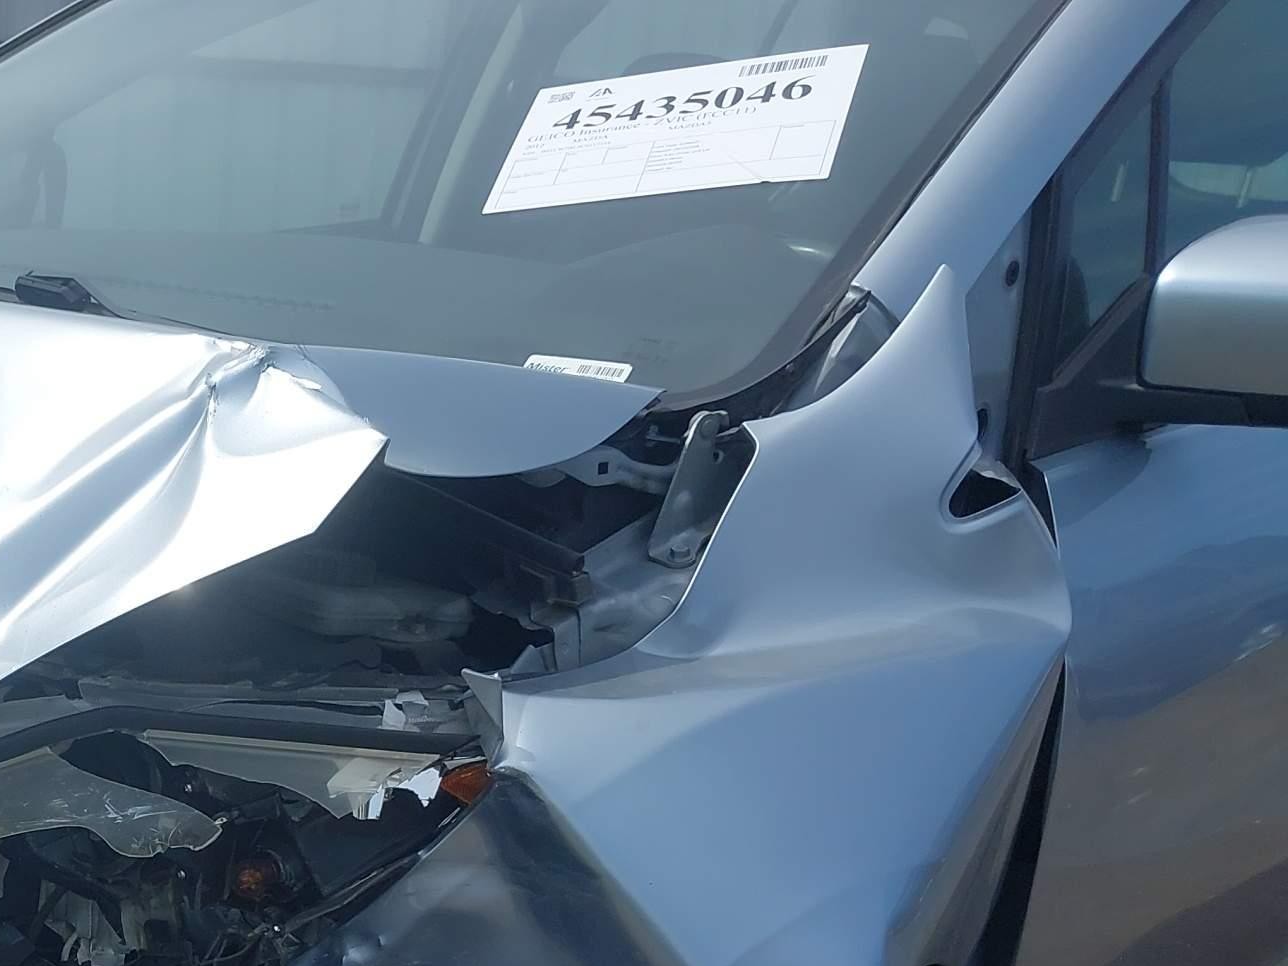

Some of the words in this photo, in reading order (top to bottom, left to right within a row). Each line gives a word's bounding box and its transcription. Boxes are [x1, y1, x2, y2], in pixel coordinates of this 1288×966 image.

[552, 75, 816, 130] 45435046
[527, 130, 576, 143] GEICO
[579, 123, 641, 136] Insurance
[526, 362, 568, 374] Mister
